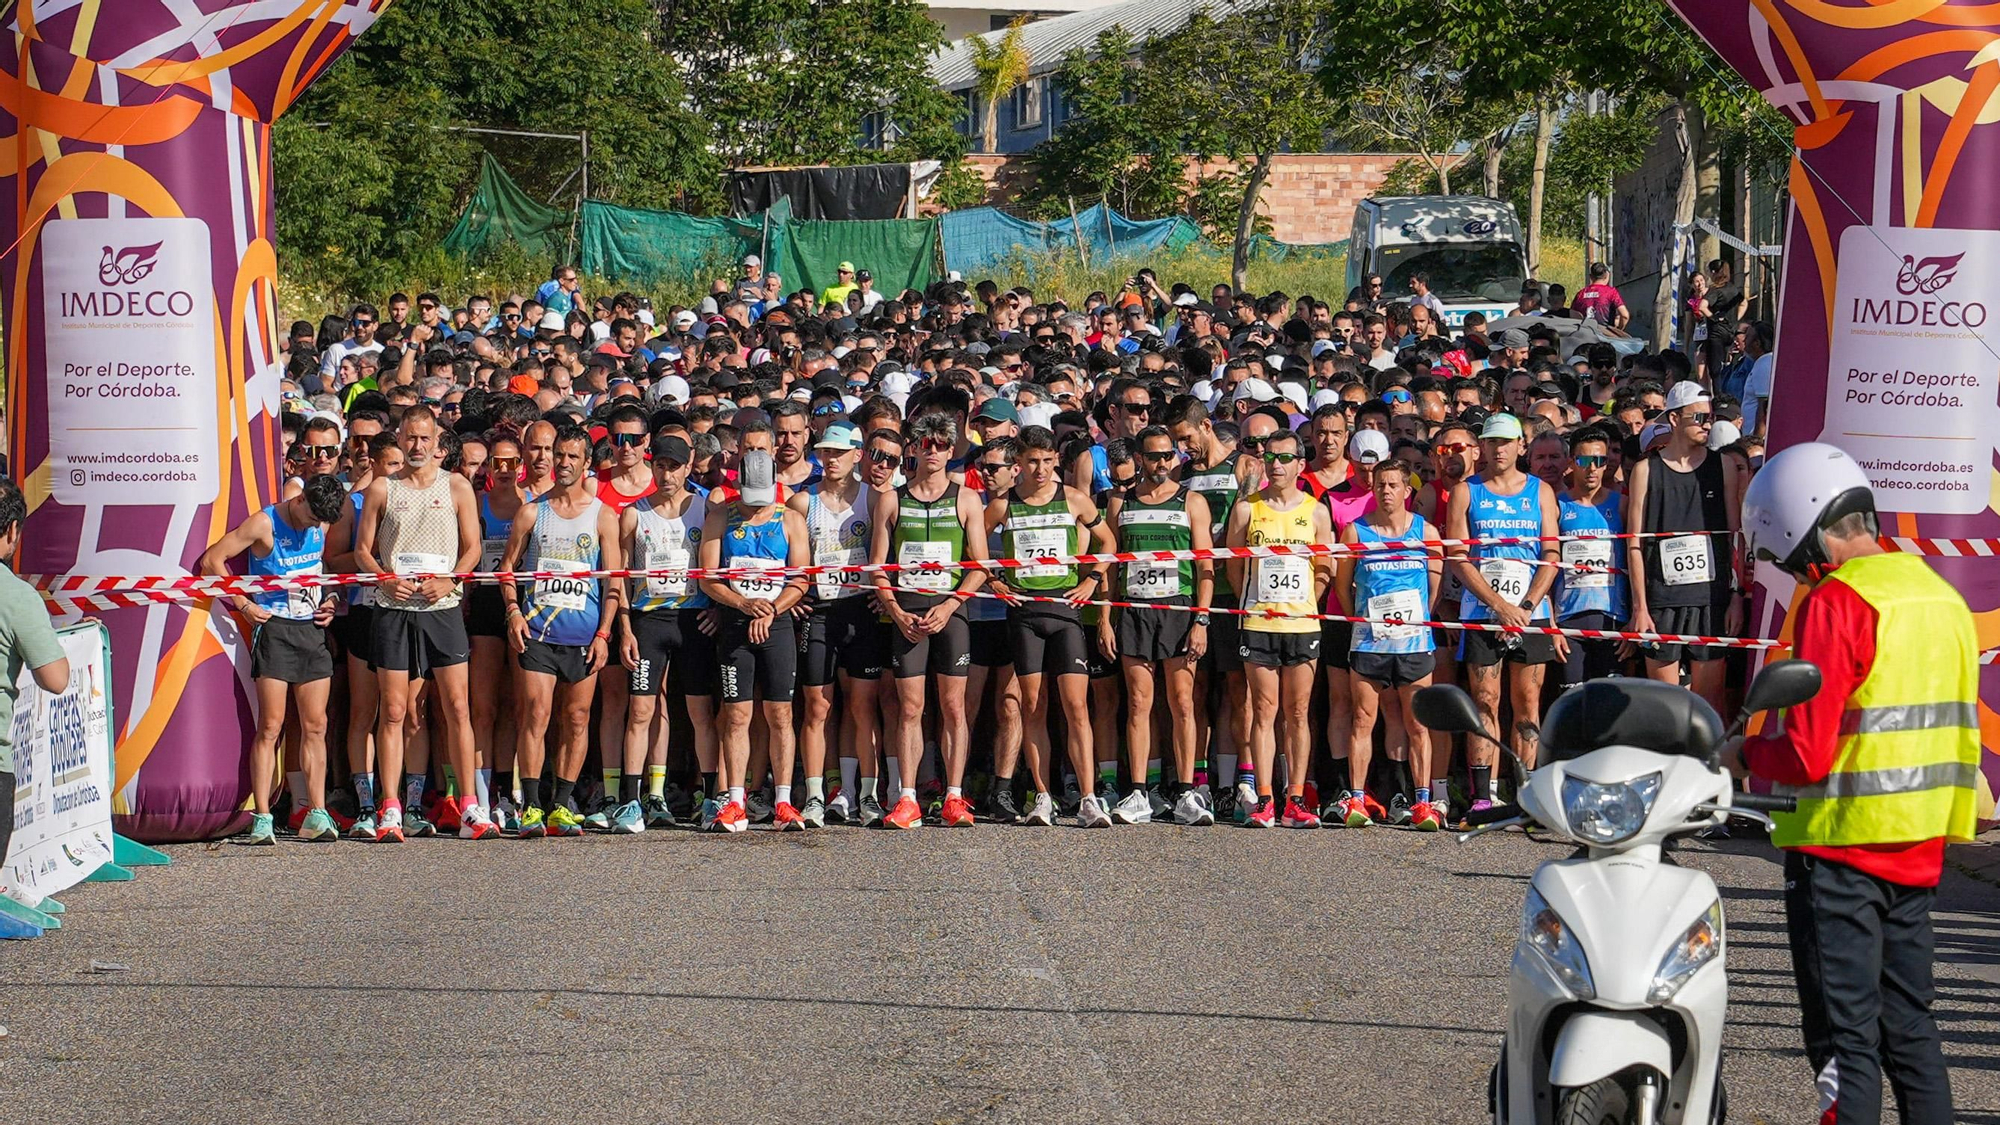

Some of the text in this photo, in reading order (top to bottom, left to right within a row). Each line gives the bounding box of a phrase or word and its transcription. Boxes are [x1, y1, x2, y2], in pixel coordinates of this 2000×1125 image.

[61, 291, 194, 317] IMDECO
[1852, 298, 1986, 327] IMDECO
[61, 322, 87, 330] Instituto
[88, 322, 120, 330] Municipal
[133, 322, 164, 330] Deportes
[1850, 328, 1879, 336] Instituto
[1879, 330, 1912, 338] Municipal
[1925, 331, 1955, 339] Deportes
[64, 362, 195, 380] Por el Deporte.
[1847, 368, 1980, 389] Por el Deporte.
[65, 382, 181, 398] Por Córdoba.
[1845, 389, 1964, 408] Por Córdoba.
[67, 452, 199, 464] www.imdcordoba.es
[1856, 459, 1974, 473] w.imdcordoba.es
[90, 470, 197, 482] imdeco.cordoba
[1870, 478, 1970, 491] mdeco.cordoba
[1475, 519, 1538, 531] TROTASIERRA
[491, 558, 524, 573] 22
[1364, 561, 1424, 572] TROTASIERRA
[1673, 554, 1706, 572] 635
[740, 578, 774, 592] 493
[828, 571, 861, 586] 505
[1137, 569, 1167, 586] 351
[1269, 573, 1300, 590] 345
[541, 579, 583, 597] 1000
[1490, 578, 1521, 596] 846
[1383, 609, 1413, 628] 587
[640, 658, 650, 691] SURCO
[727, 665, 739, 698] SURCO
